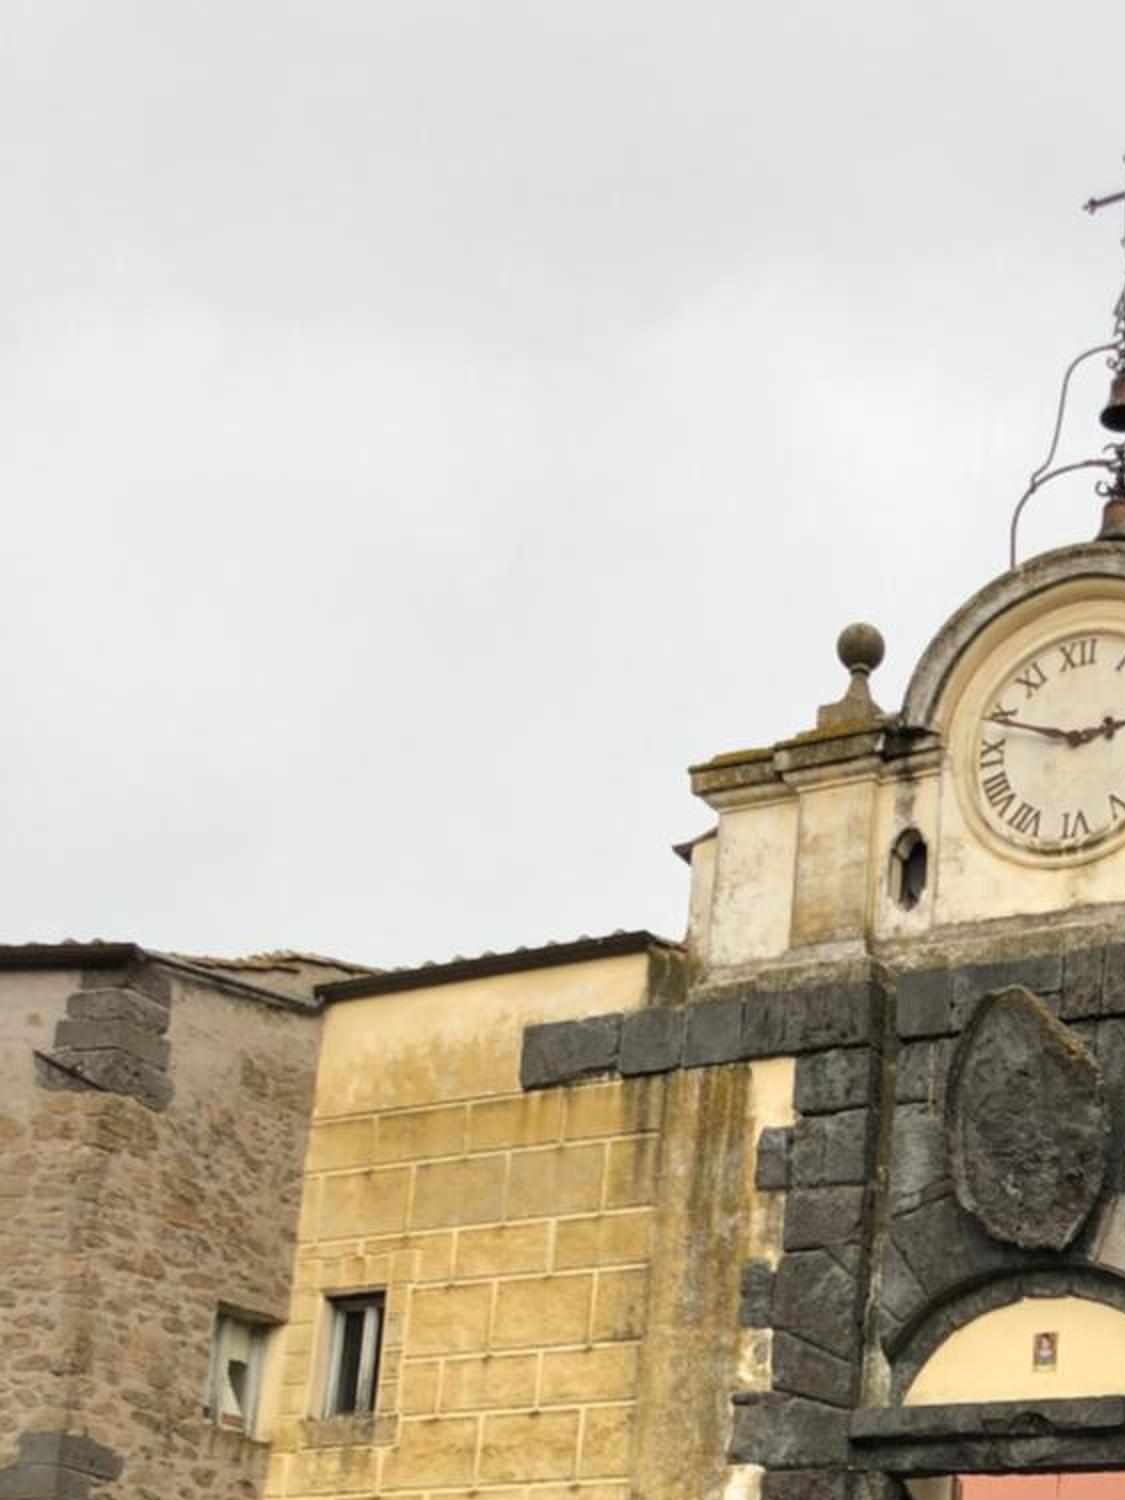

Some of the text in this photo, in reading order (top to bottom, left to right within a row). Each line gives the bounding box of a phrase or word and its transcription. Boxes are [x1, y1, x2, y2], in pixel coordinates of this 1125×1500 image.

[1059, 638, 1097, 672] XII
[1016, 662, 1048, 699] XI
[980, 738, 1005, 769] IX
[983, 771, 1016, 818] VIII
[1006, 801, 1041, 837] VII
[1061, 809, 1090, 839] VI
